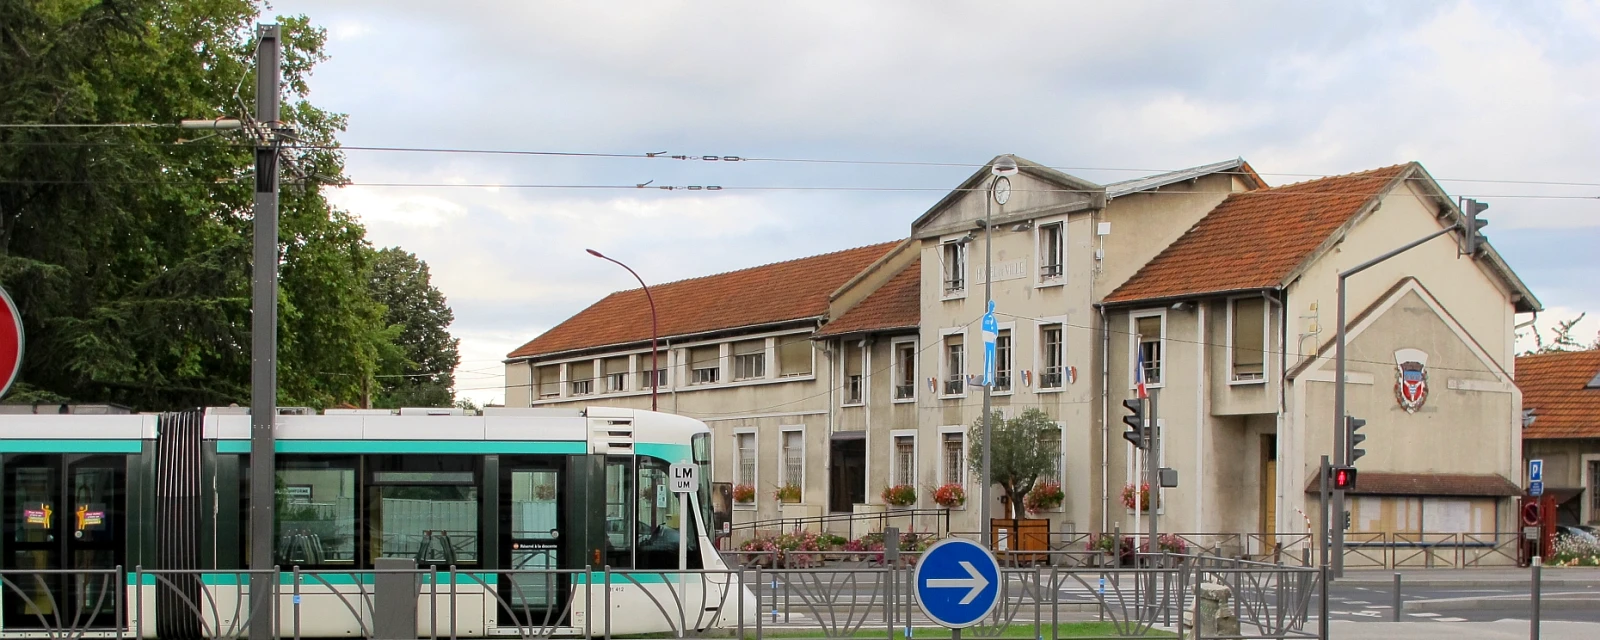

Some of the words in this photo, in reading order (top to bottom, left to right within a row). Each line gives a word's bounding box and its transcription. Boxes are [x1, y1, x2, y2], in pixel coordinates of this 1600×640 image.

[1004, 261, 1025, 276] VILLE
[675, 467, 693, 479] LM
[1532, 464, 1539, 478] P
